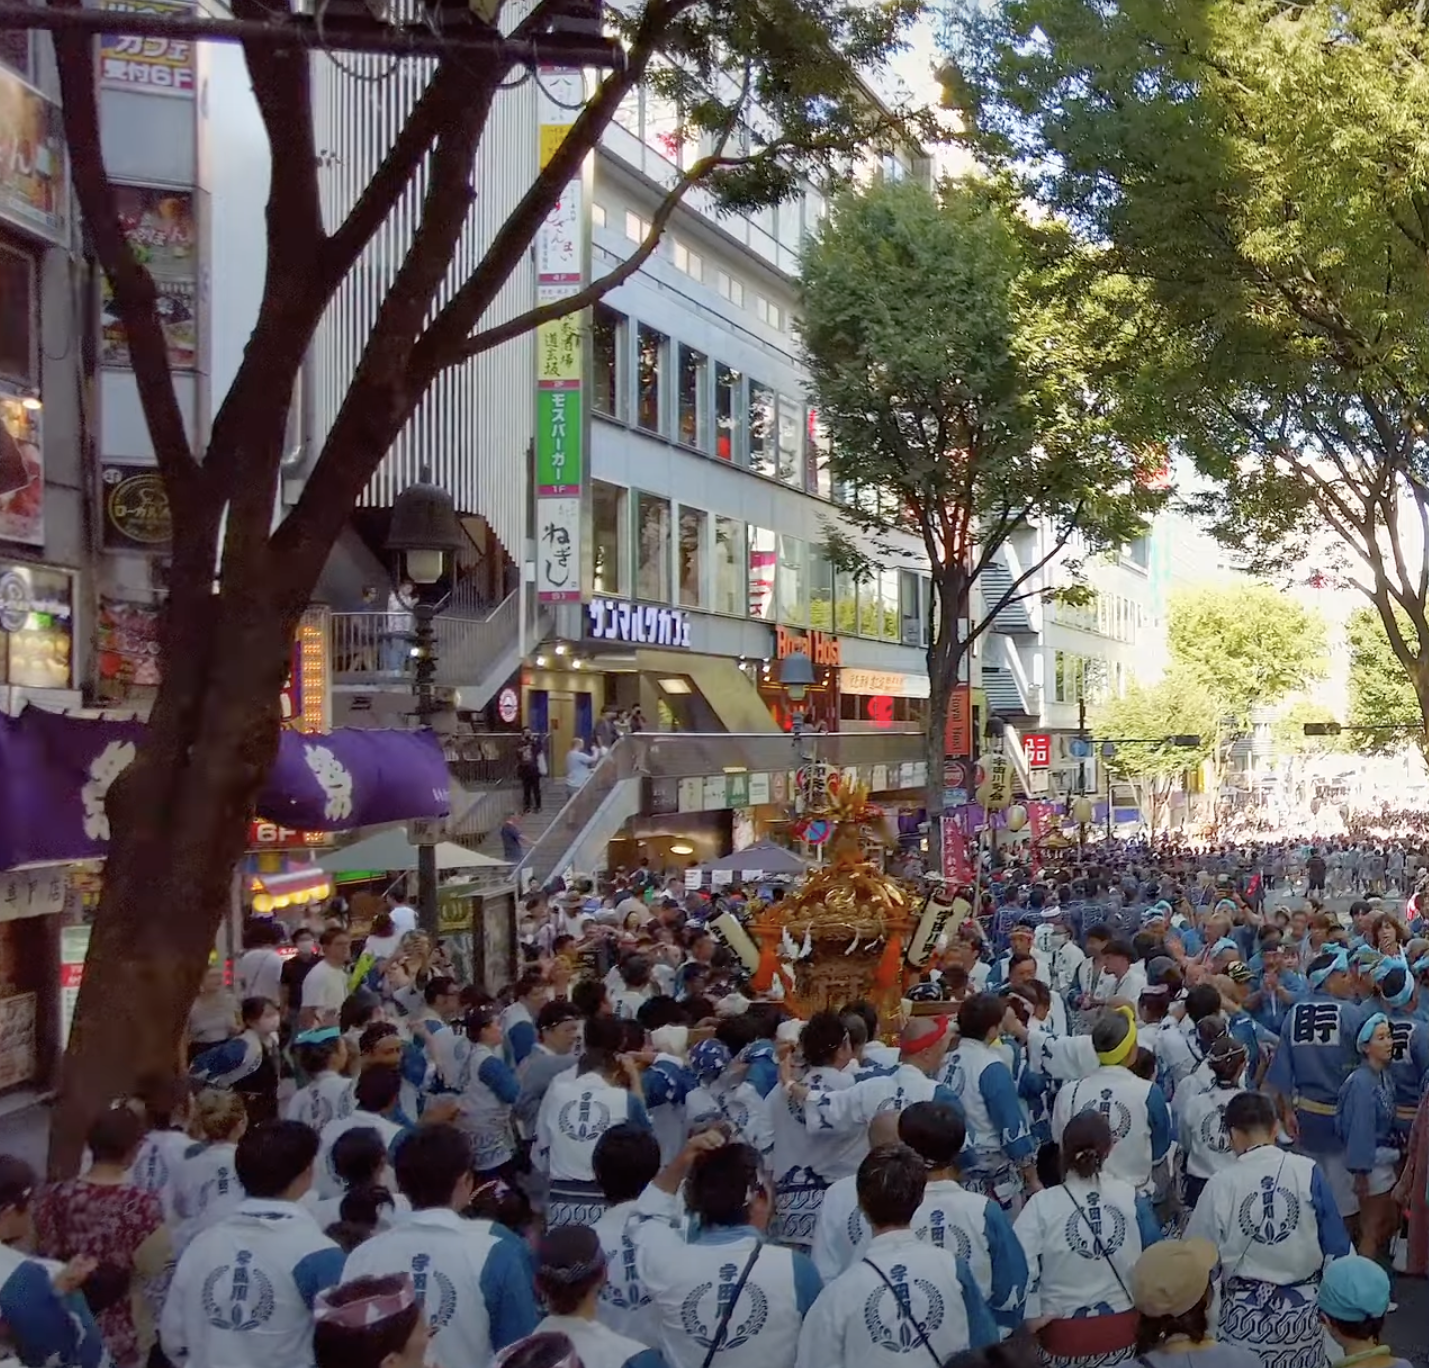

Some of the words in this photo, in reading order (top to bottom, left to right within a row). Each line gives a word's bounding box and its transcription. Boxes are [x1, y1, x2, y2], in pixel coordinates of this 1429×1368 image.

[116, 36, 190, 60] カフェ
[104, 59, 192, 89] 受付6F
[551, 392, 566, 481] モスバーガー
[552, 486, 567, 494] 1F
[543, 523, 571, 589] ねぎし
[588, 598, 691, 648] サンマルクカフェ
[814, 630, 843, 666] Host
[1026, 738, 1046, 749] ユニ
